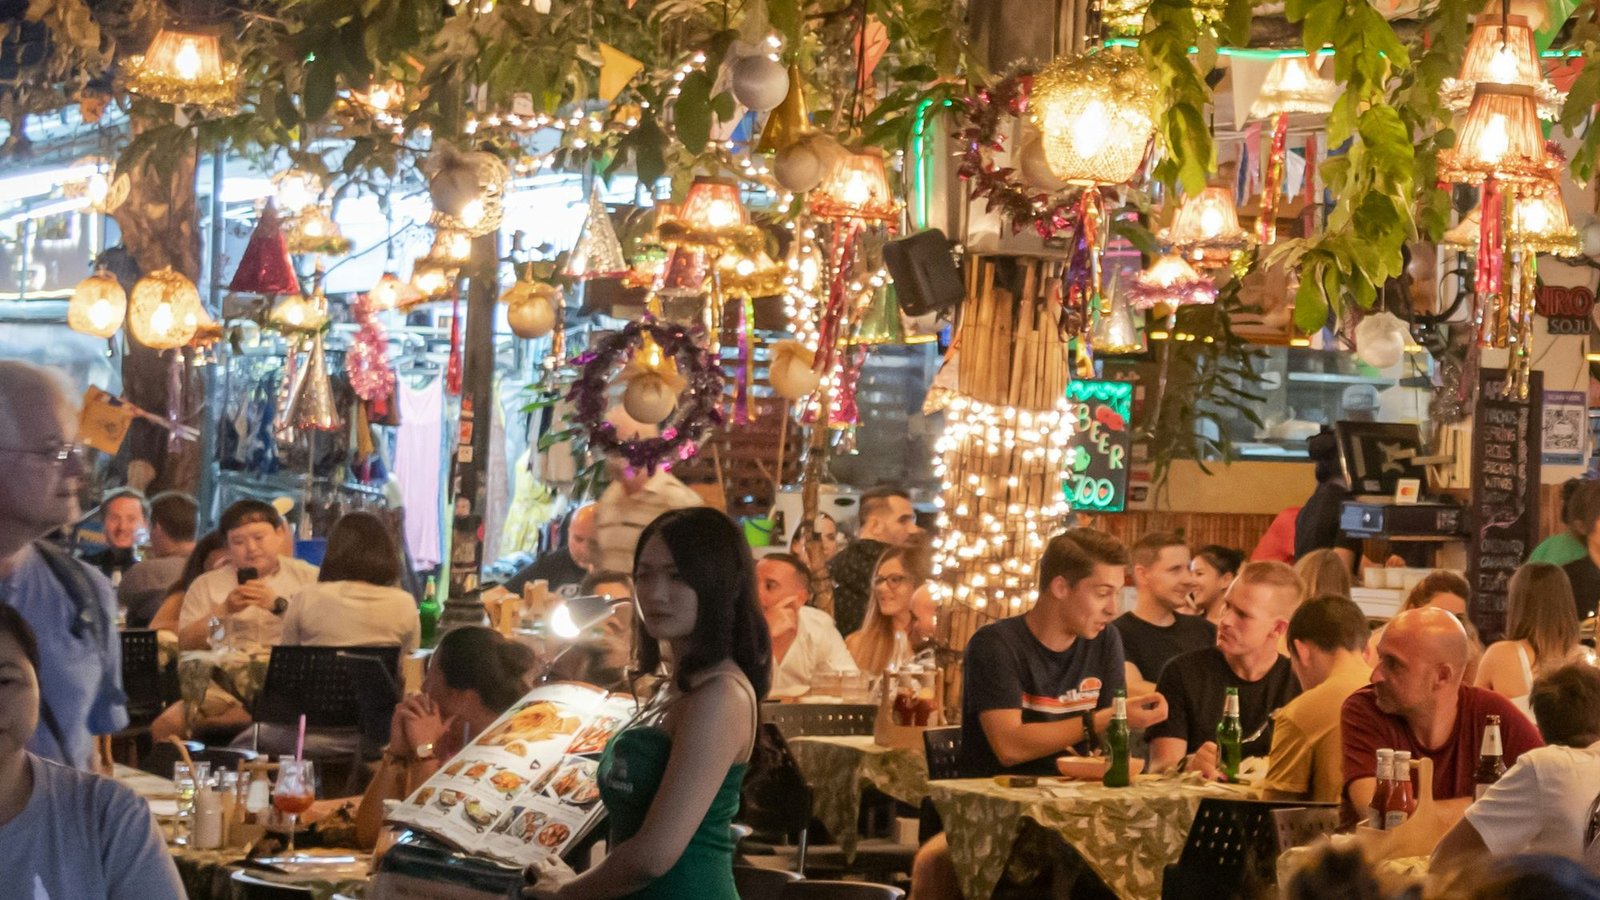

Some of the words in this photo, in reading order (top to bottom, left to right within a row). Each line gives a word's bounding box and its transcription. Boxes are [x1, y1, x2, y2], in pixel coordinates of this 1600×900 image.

[1535, 286, 1595, 317] NRO
[1551, 319, 1593, 334] SOJU
[1074, 402, 1125, 470] BEER
